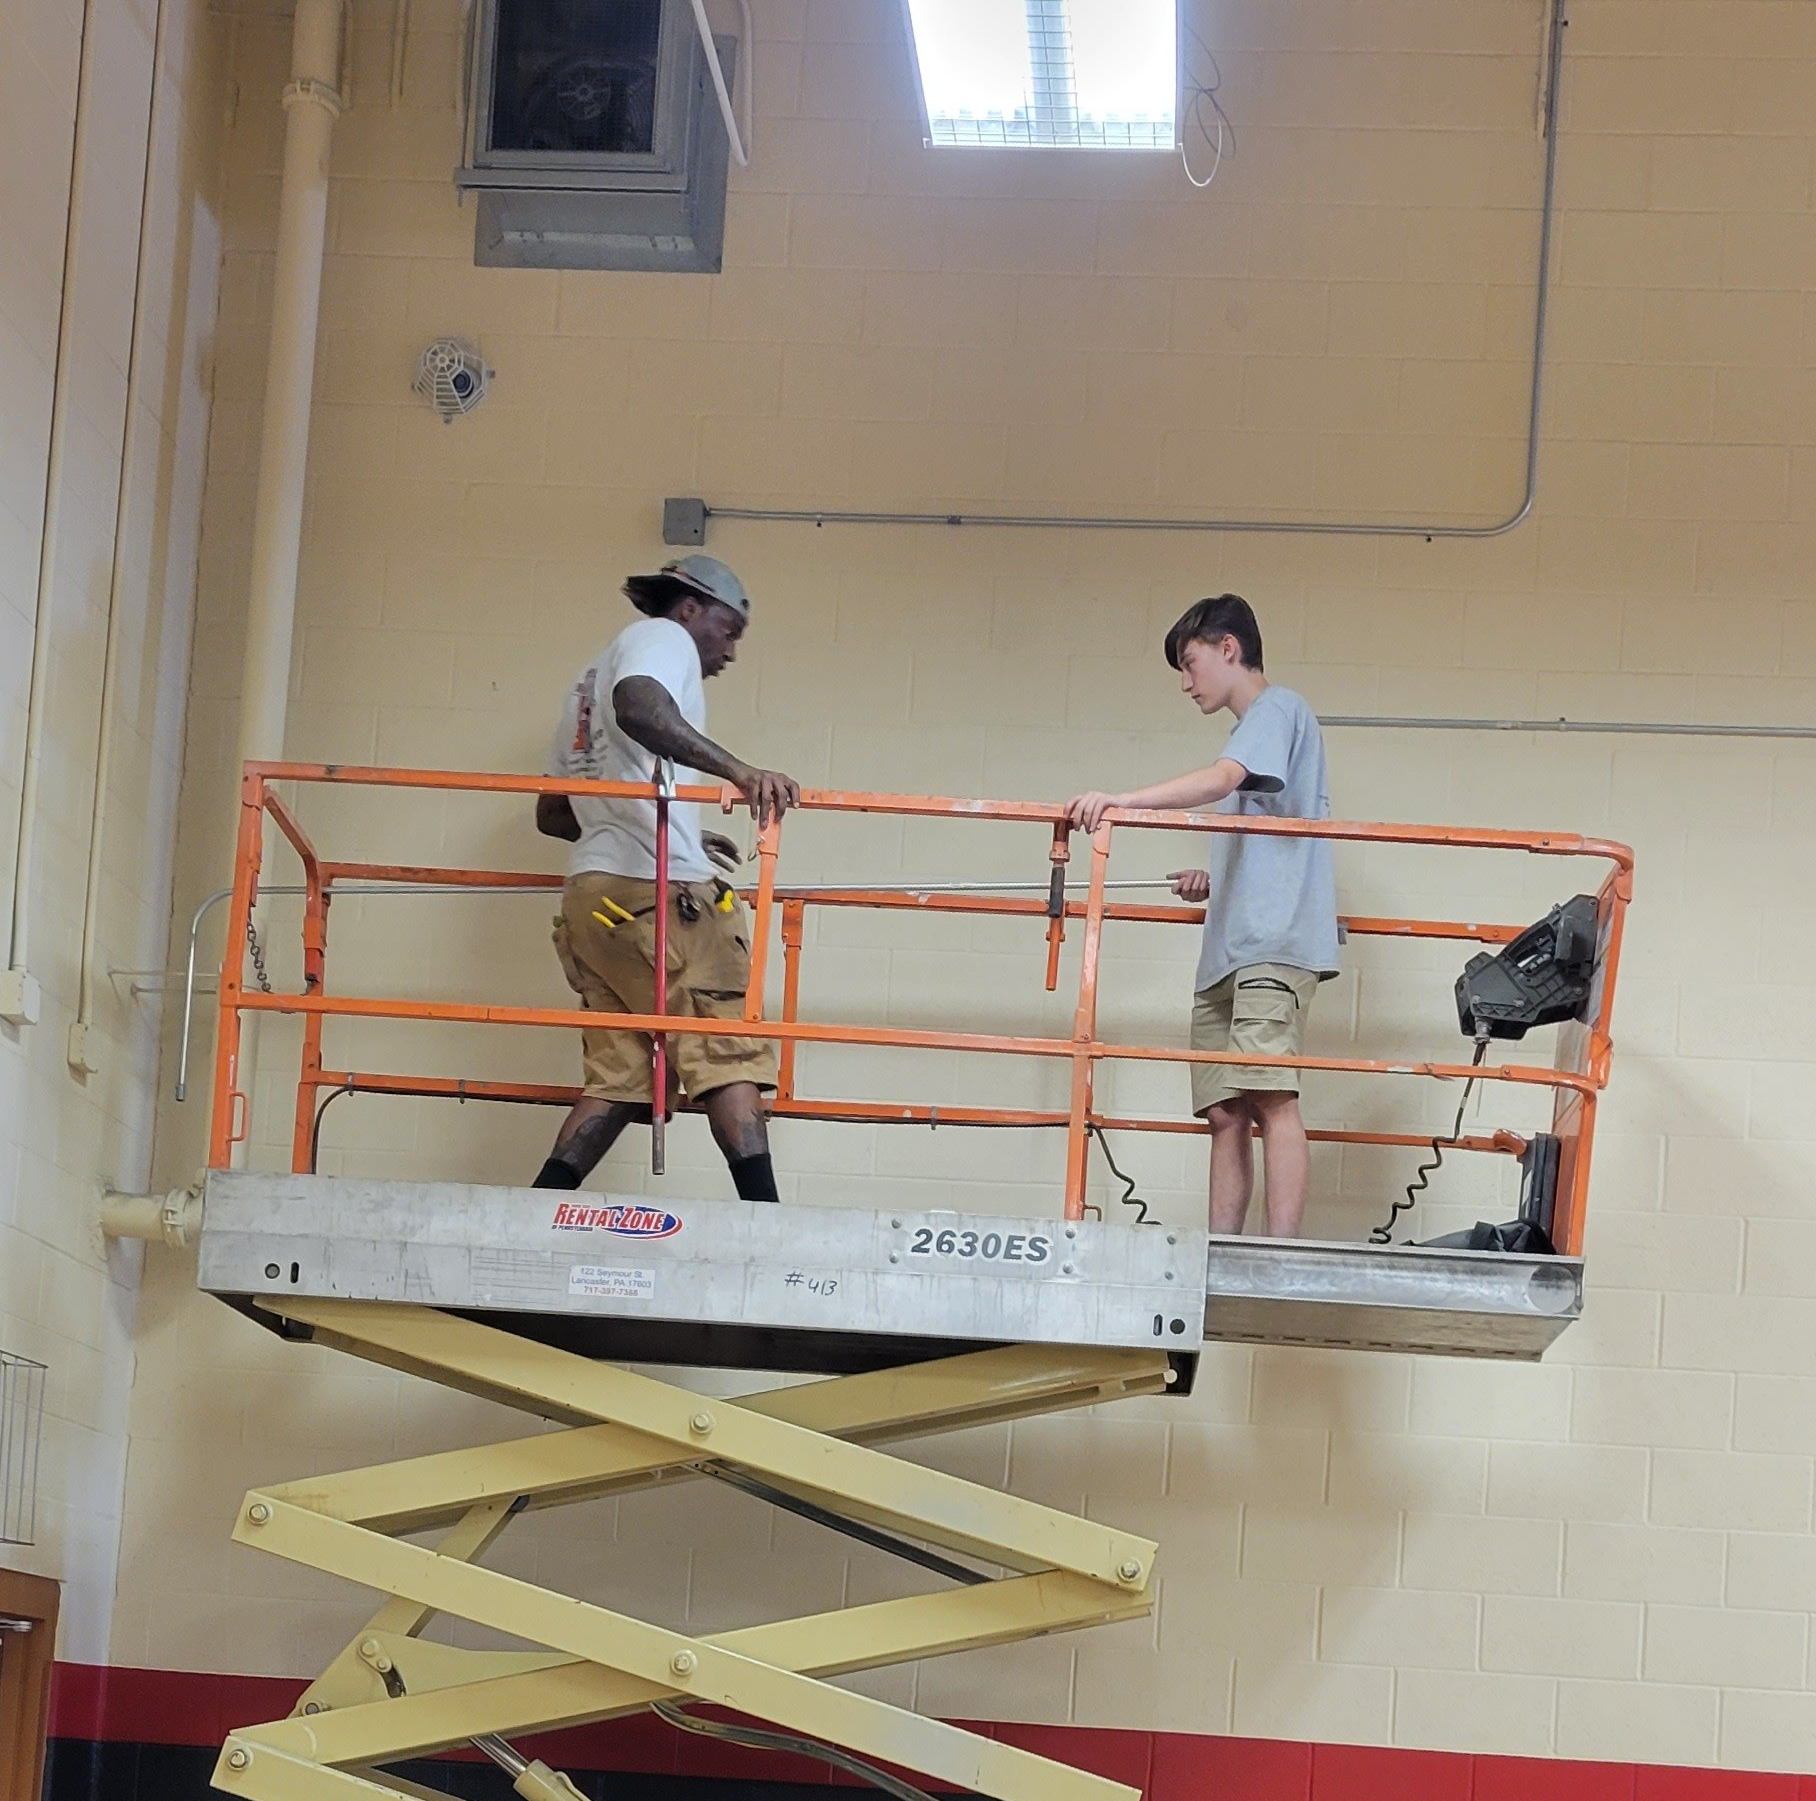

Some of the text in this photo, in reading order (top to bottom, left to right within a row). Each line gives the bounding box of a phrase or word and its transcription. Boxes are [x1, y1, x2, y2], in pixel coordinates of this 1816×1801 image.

[553, 1203, 665, 1230] RENTAL ZONE
[911, 1228, 1049, 1262] 2630ES
[581, 1267, 594, 1276] 122
[597, 1268, 632, 1278] Seymour
[628, 1280, 652, 1288] 17603
